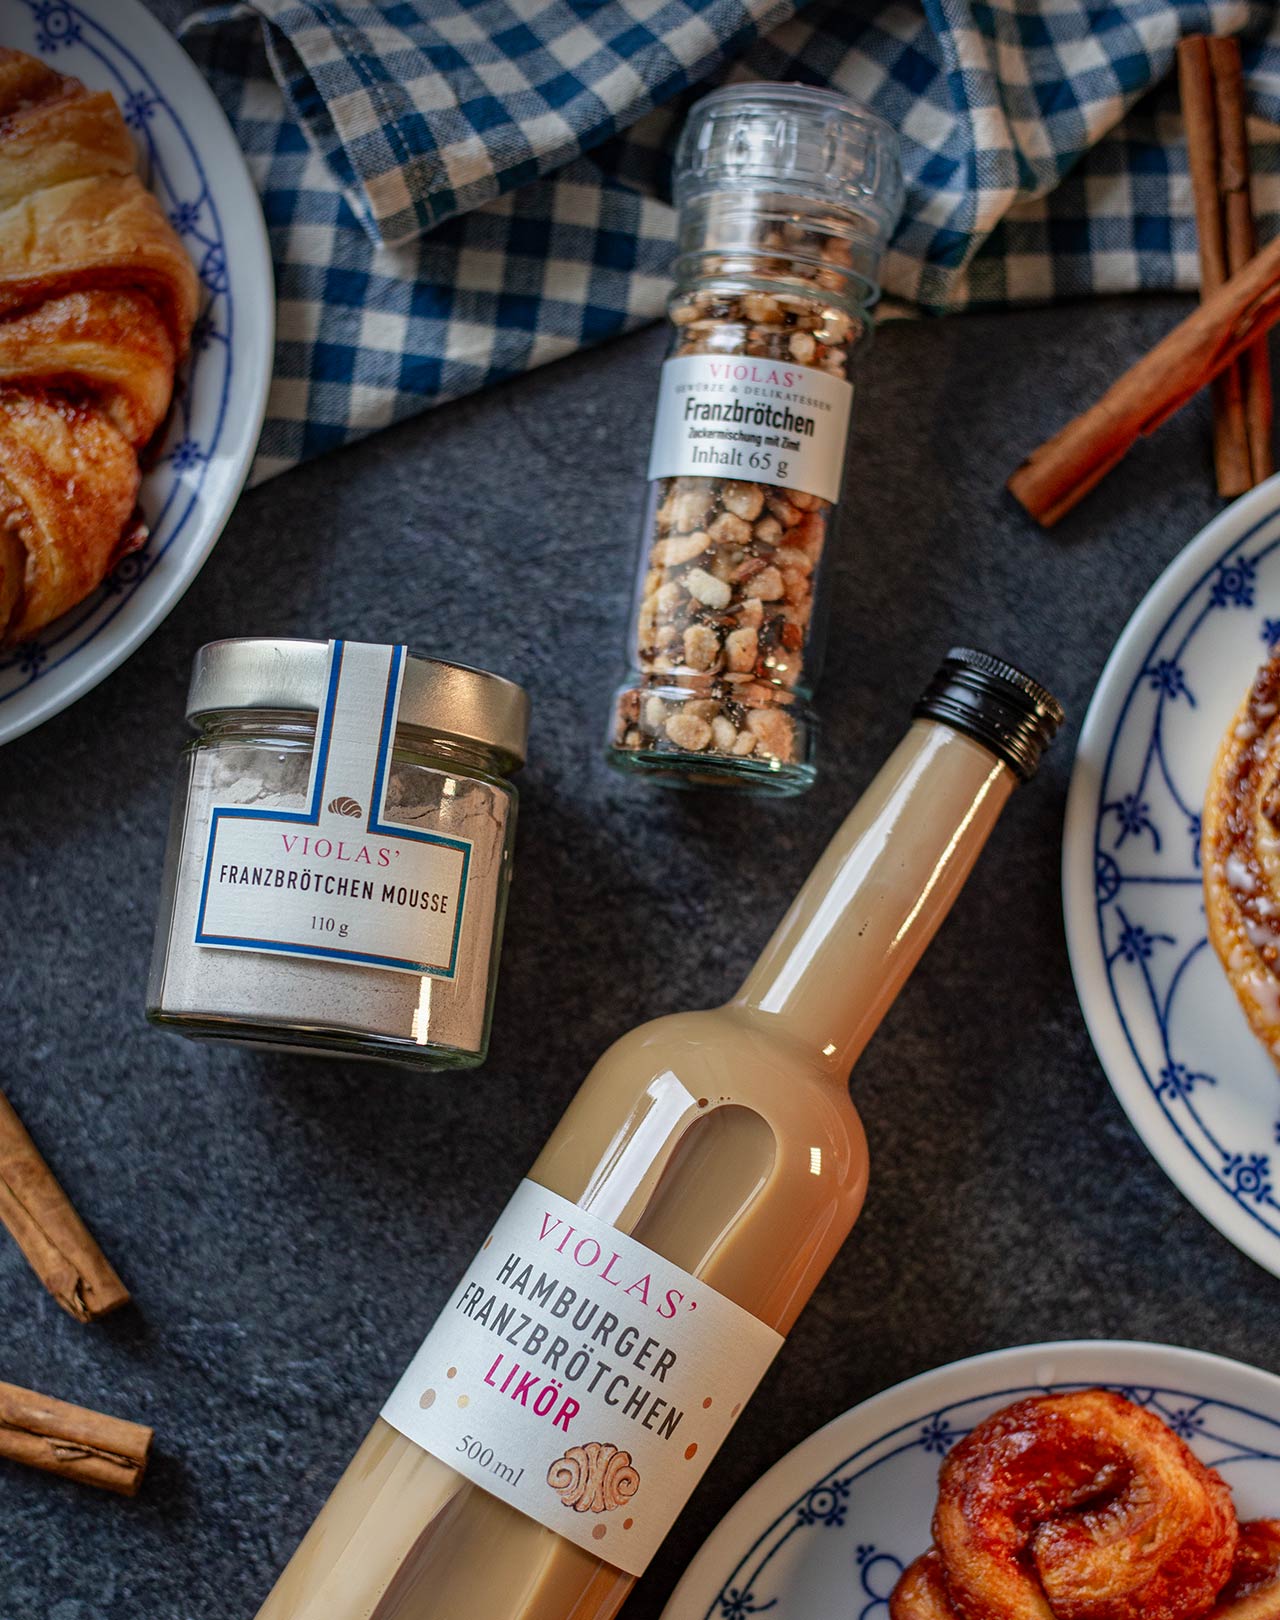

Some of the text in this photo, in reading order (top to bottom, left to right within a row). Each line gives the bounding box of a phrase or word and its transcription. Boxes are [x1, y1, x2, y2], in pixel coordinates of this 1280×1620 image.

[684, 397, 815, 437] Franzbrötchen
[731, 384, 739, 394] &
[744, 385, 832, 412] DELIKATESSEN
[688, 427, 800, 451] Zuckermischung mit Zimt
[691, 446, 789, 478] Inhalt 65 g
[219, 864, 449, 914] FRANZBRÖTCHEN MOUSSE
[311, 916, 350, 938] 110 g
[496, 1253, 677, 1383] HAMBURGER
[456, 1282, 684, 1441] FRANZBRÖTCHEN
[483, 1353, 581, 1433] LIKÖR
[455, 1434, 525, 1488] 500 ml
